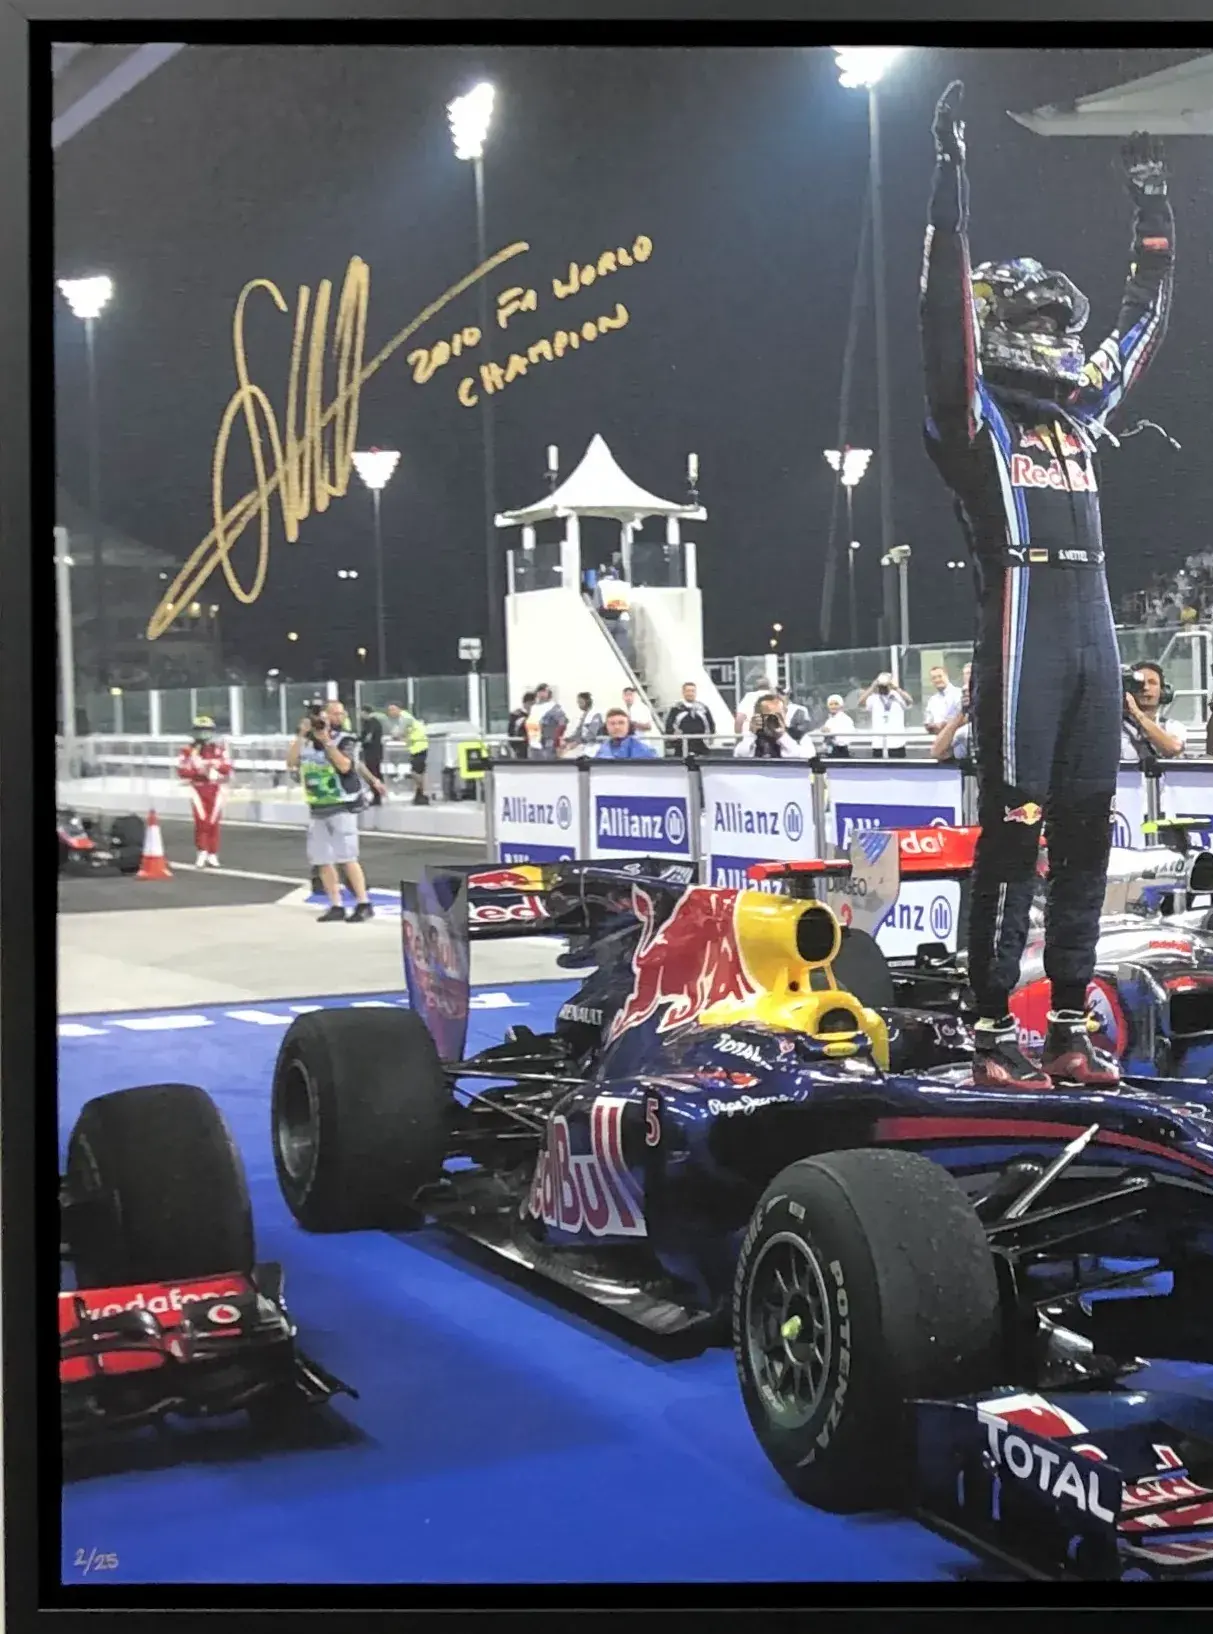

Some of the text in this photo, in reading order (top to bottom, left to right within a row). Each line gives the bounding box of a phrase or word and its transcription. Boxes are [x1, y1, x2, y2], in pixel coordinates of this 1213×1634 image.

[407, 326, 481, 384] 2010
[552, 235, 653, 299] WORLD
[458, 303, 629, 407] CHAMPION
[502, 796, 554, 825] Allianz
[600, 807, 663, 840] Allianz
[715, 801, 779, 836] Allianz
[645, 1097, 661, 1146] 5
[977, 1409, 1115, 1524] TOTAL
